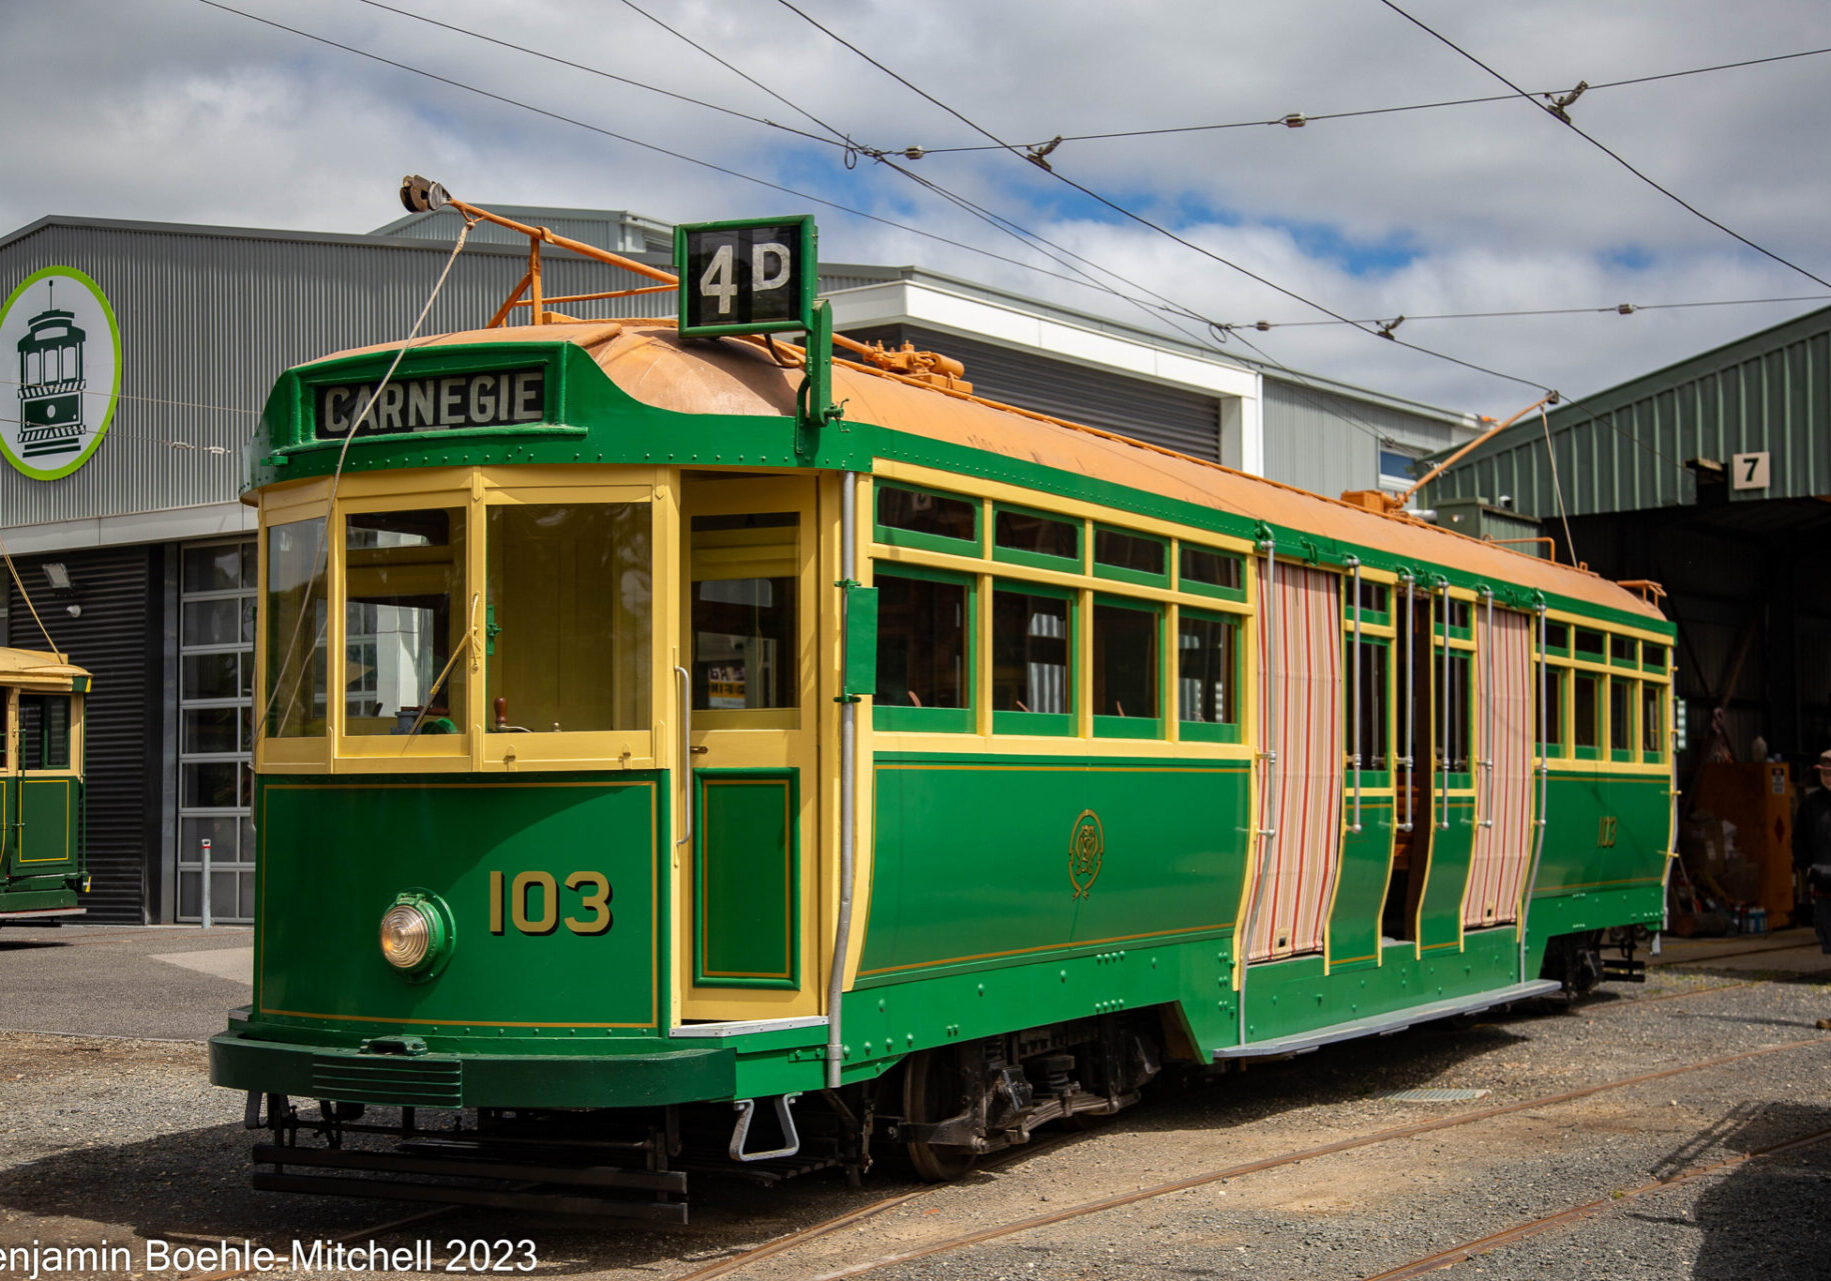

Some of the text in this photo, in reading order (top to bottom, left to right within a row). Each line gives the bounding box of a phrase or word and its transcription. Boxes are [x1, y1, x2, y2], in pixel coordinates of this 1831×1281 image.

[324, 372, 543, 432] CARNEGIE
[1743, 457, 1759, 482] 7
[489, 870, 613, 936] 103
